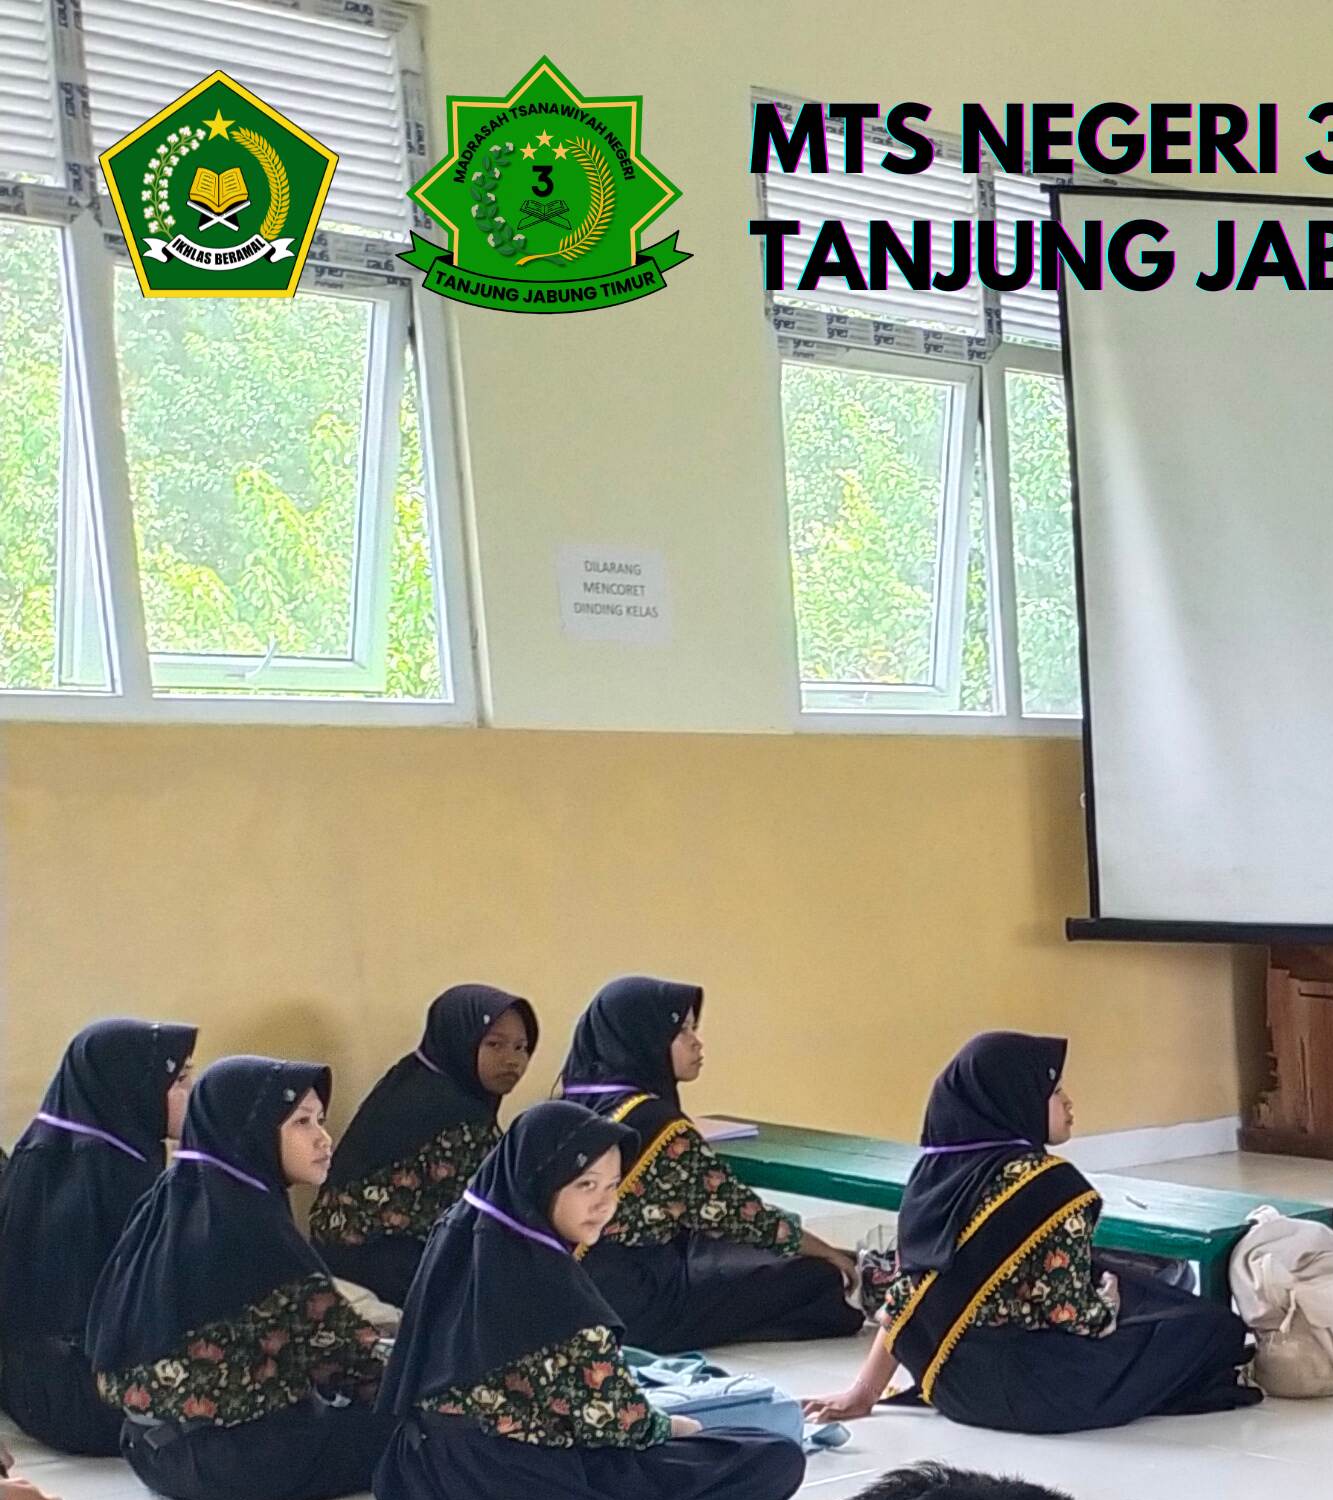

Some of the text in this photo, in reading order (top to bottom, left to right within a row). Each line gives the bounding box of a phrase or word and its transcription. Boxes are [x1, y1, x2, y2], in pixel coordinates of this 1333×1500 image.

[584, 560, 642, 576] DILARANG
[583, 581, 646, 597] MENCORET
[573, 602, 659, 618] DINDING KELAS
